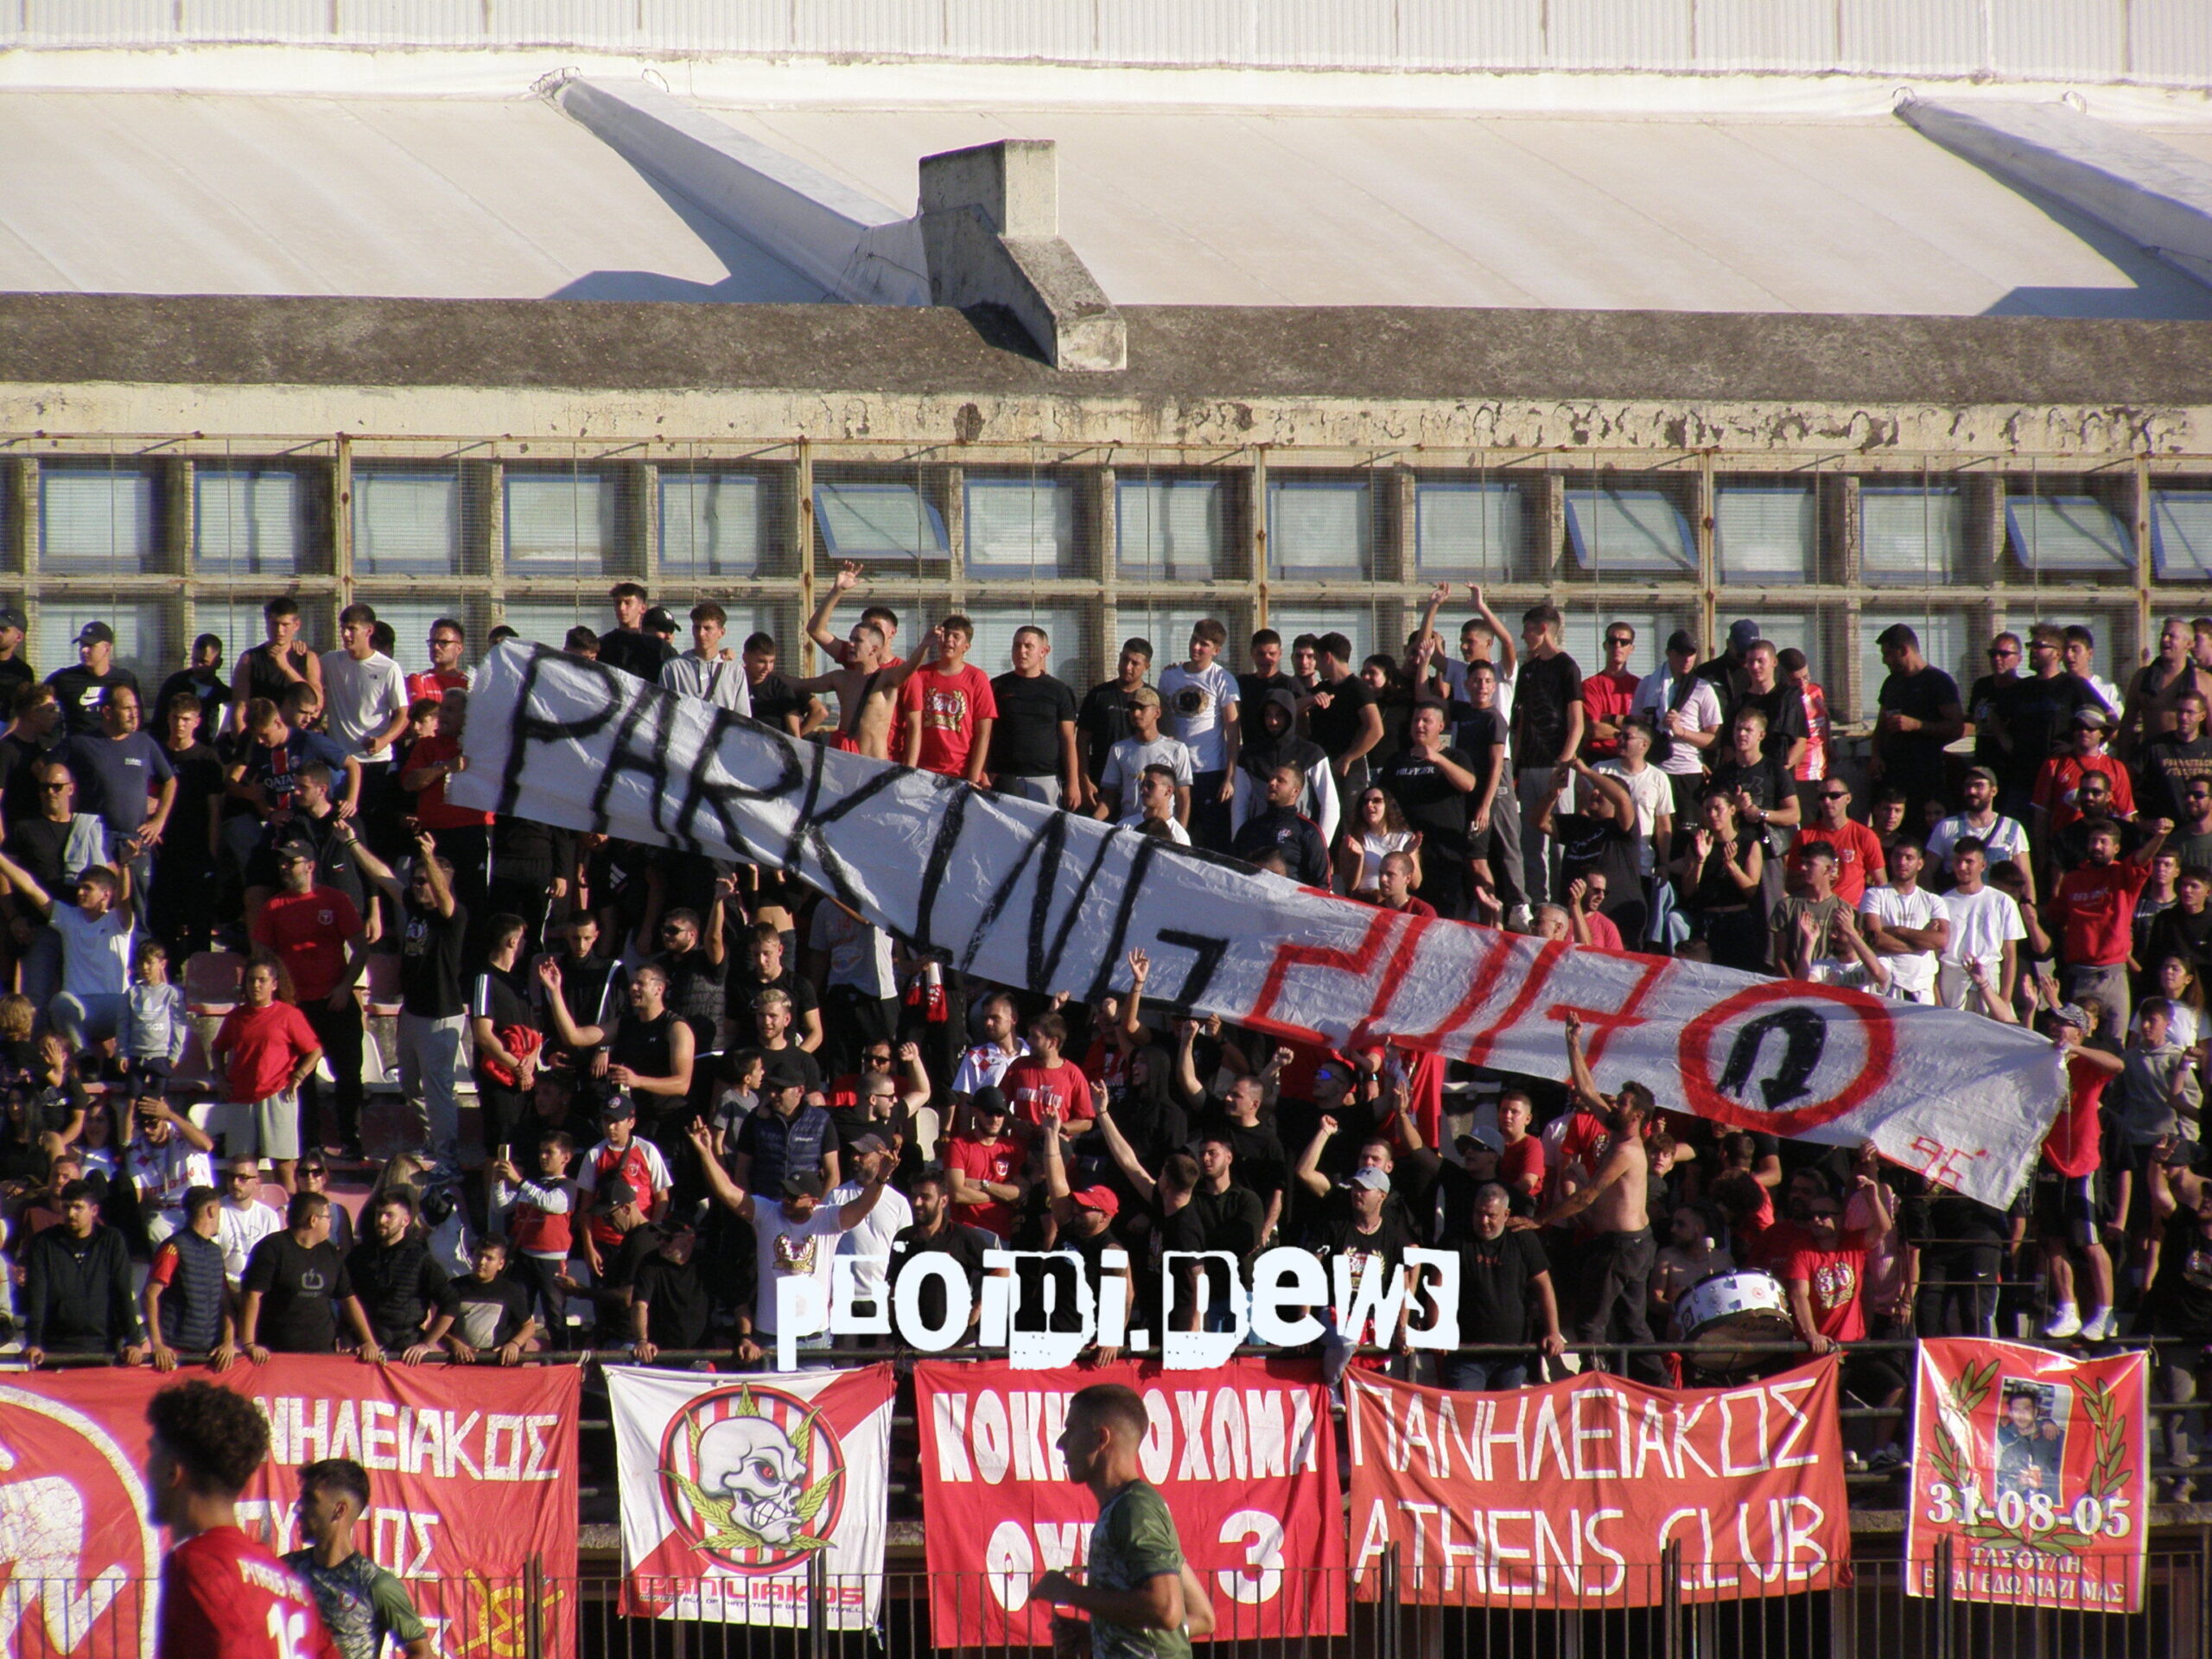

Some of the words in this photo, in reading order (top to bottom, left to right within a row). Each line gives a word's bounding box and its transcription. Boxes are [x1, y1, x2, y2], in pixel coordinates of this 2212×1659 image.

[497, 642, 1262, 1016] PARKING
[252, 1396, 559, 1481] ΝΗΛΕΙΑΚΟΣ
[932, 1389, 1318, 1485] ΚΟΚΚΟΧΩΜΑ
[1349, 1377, 1819, 1483] ΠΑΝΗΛΕΙΑΚΟΣ
[1218, 1510, 1285, 1605] 3
[1353, 1499, 1626, 1597] ATHENS
[1658, 1496, 1828, 1592] CLUB
[1927, 1484, 2132, 1538] 31-08-05
[1924, 1568, 1974, 1592] ΕΑΙ
